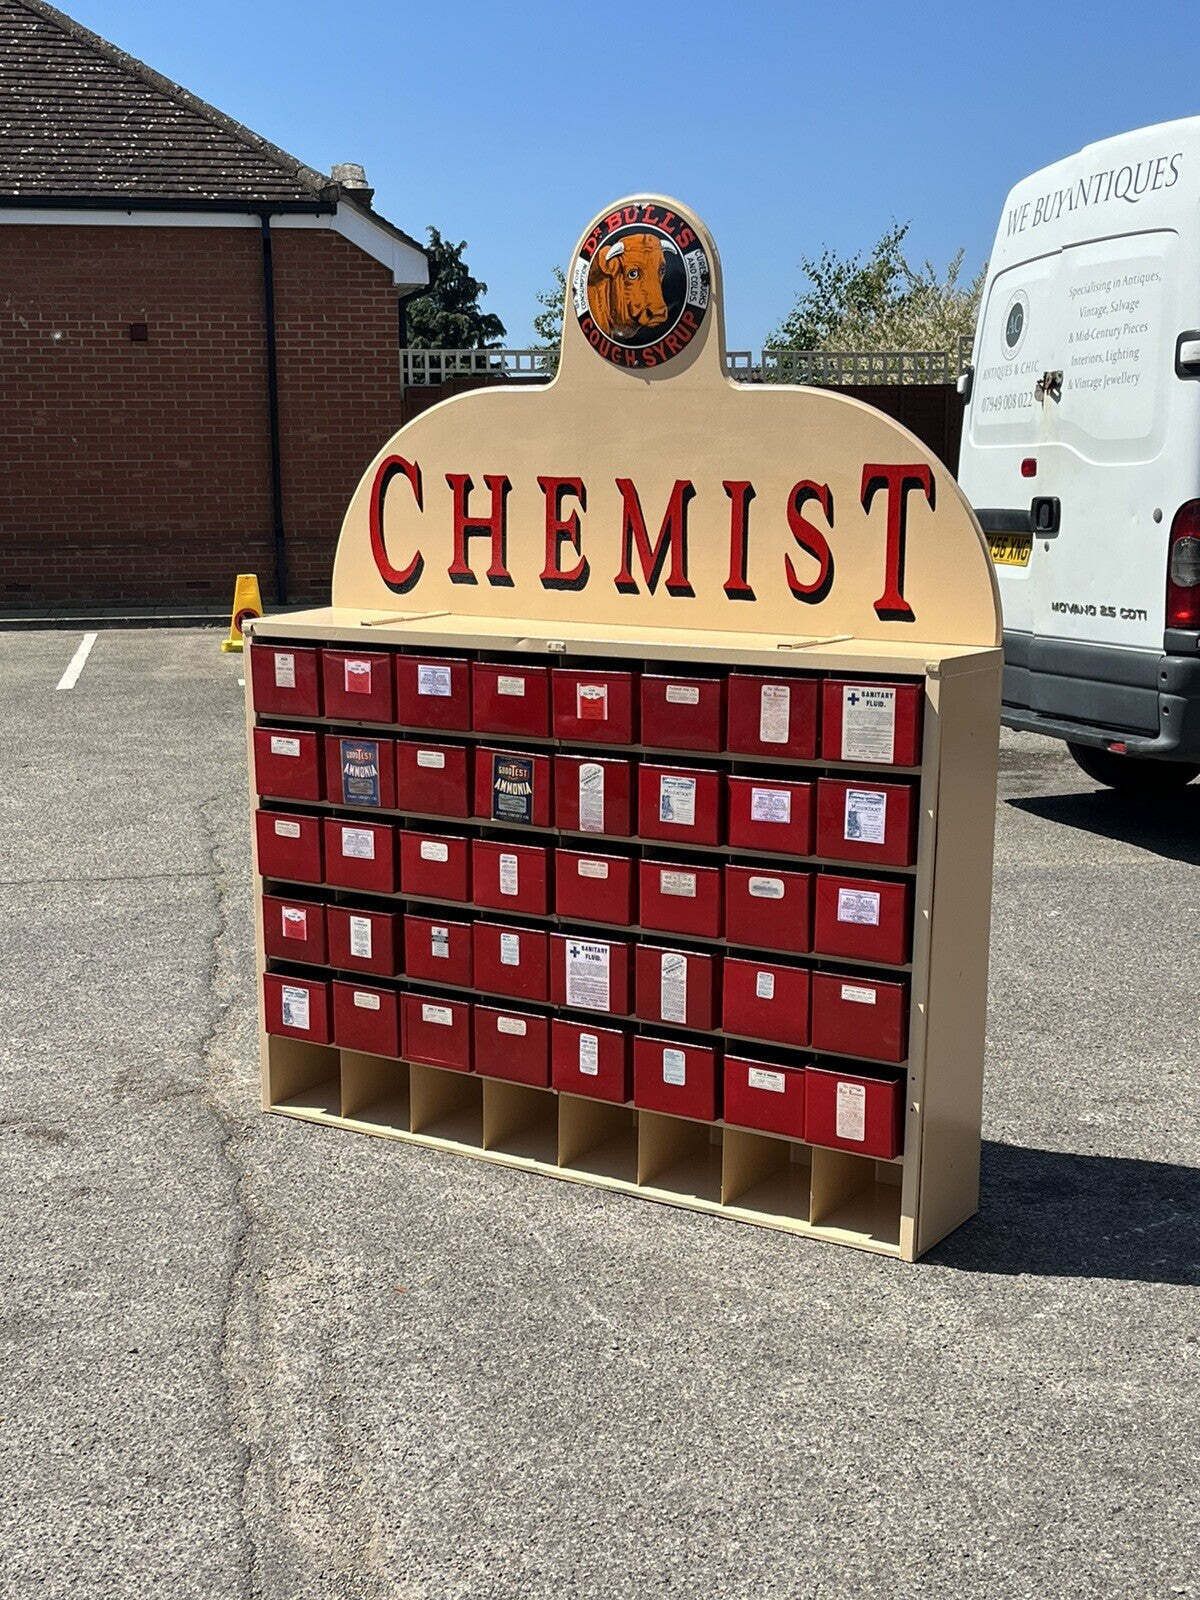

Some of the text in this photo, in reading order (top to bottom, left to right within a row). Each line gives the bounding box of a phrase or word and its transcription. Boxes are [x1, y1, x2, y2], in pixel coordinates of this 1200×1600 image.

[1007, 203, 1031, 238] WE
[1032, 190, 1068, 228] BUY
[687, 257, 697, 274] AND
[1113, 278, 1121, 288] in
[1111, 299, 1140, 313] Salvage
[1123, 322, 1149, 334] Pieces
[582, 310, 700, 366] COUGH SYRUP
[1105, 348, 1141, 364] Lighting
[1021, 361, 1040, 374] CHIC
[1074, 376, 1103, 392] Vintage
[1103, 371, 1141, 390] Jewellery
[369, 454, 936, 623] CHEMIST
[1051, 602, 1097, 617] MOVANO
[861, 691, 894, 699] SANITARY
[866, 700, 887, 708] FLUID.
[343, 762, 379, 778] AMMONIA
[494, 778, 533, 796] AMMONIA
[581, 945, 608, 954] SANITARY
